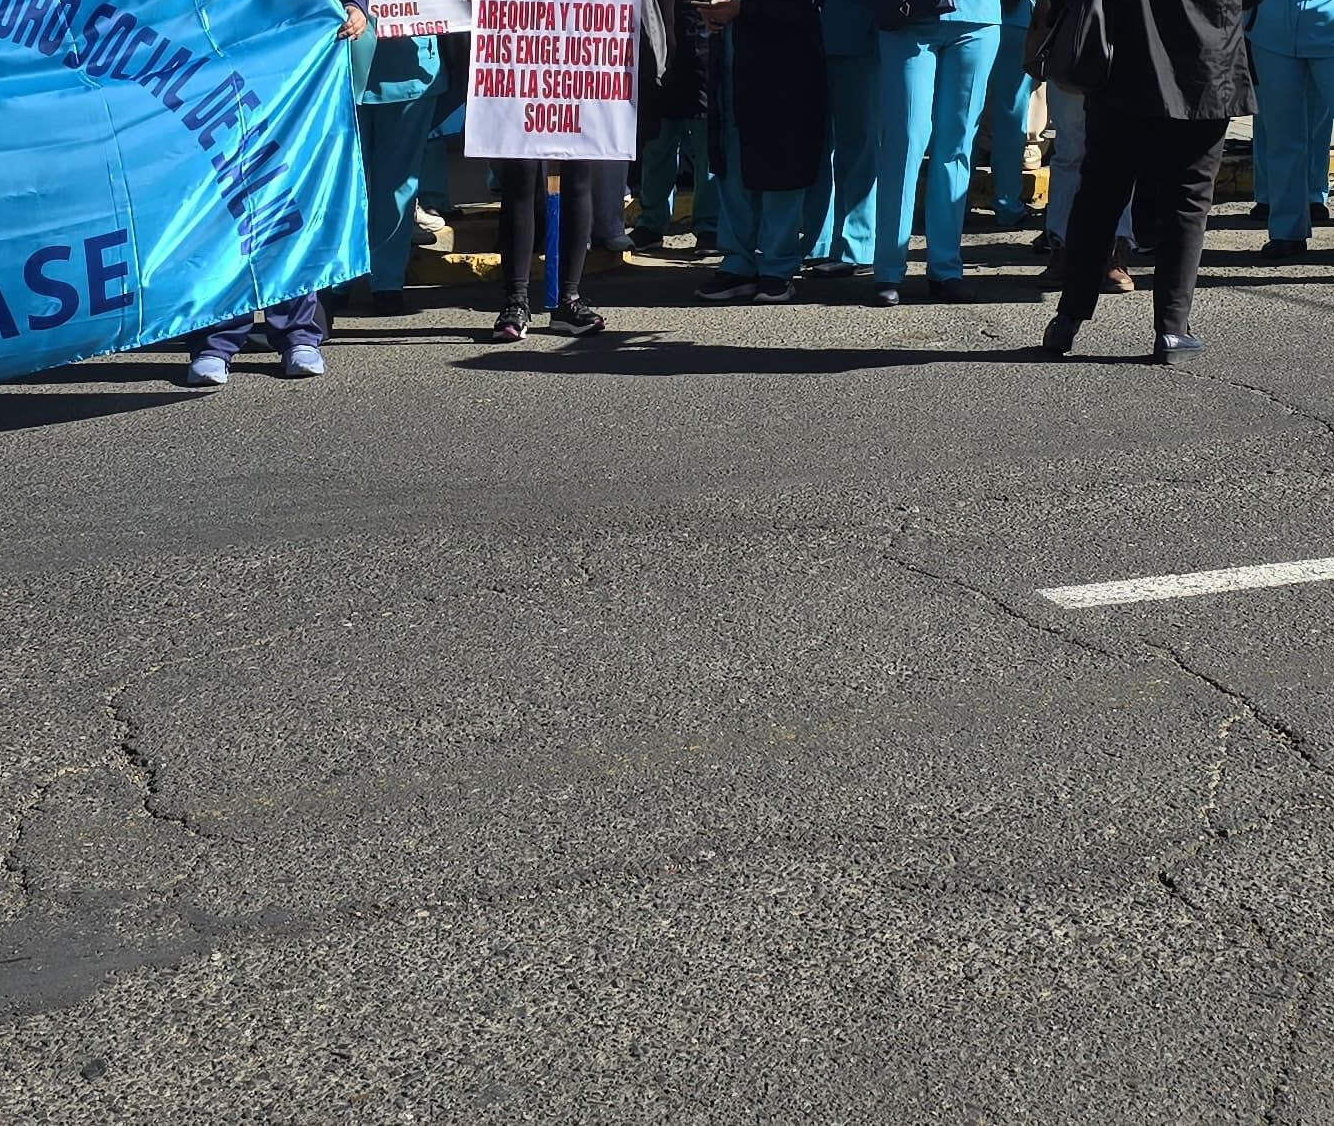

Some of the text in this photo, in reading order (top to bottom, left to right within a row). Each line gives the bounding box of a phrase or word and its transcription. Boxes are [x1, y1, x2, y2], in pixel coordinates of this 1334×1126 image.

[371, 2, 419, 18] SOCIAL
[477, 0, 634, 33] AREQUIPA Y TODO EL
[475, 28, 634, 67] PAÍS EXIGE JUSTICIA
[67, 3, 210, 111] SOCIAL
[181, 70, 261, 151] DE
[474, 69, 633, 101] PARA LA SEGURIDAD
[524, 103, 582, 133] SOCIAL
